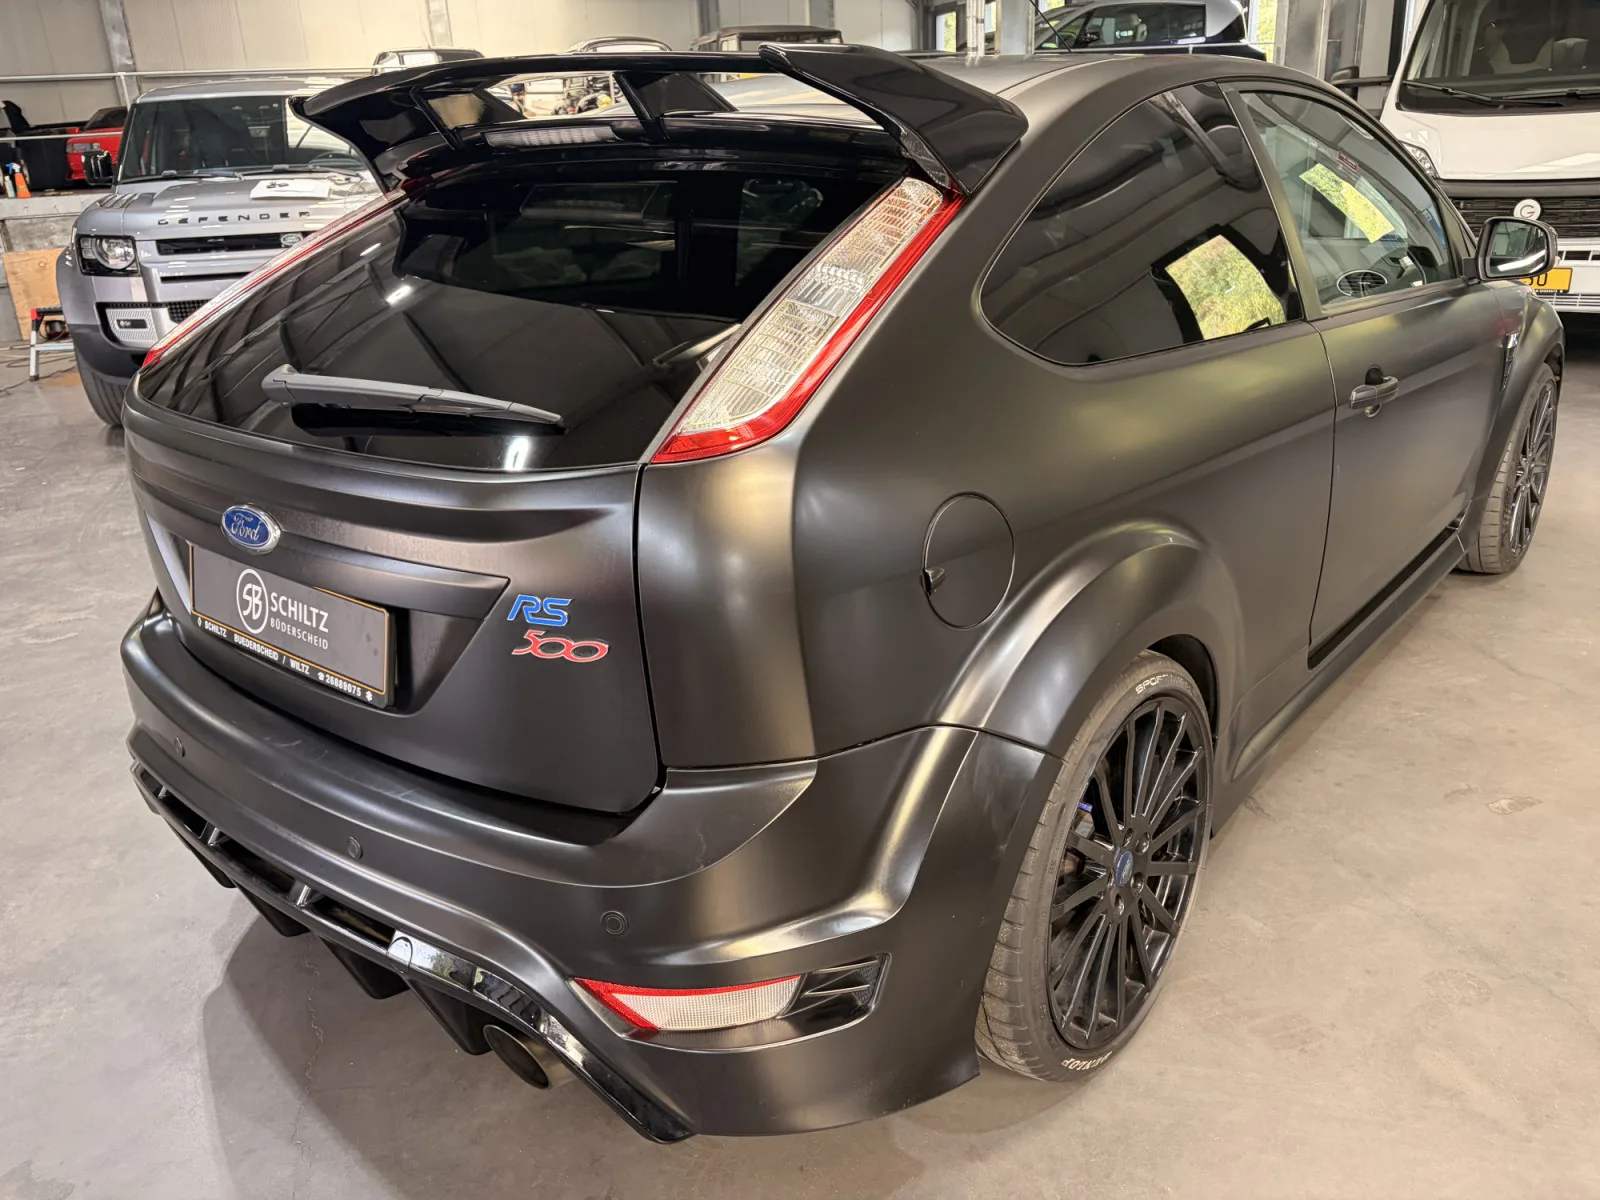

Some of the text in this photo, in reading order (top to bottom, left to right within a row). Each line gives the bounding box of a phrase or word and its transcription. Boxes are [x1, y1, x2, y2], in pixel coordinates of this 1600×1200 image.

[158, 211, 310, 225] DEFENDER
[231, 513, 262, 542] Ford
[270, 592, 329, 633] SCHILTZ
[507, 594, 572, 627] RS
[204, 621, 227, 638] SCHILTZ
[234, 633, 279, 663] BUEDERSCHEID
[290, 658, 310, 675] WILTZ
[270, 617, 329, 650] BÜDERSCHEID
[511, 630, 609, 663] 500
